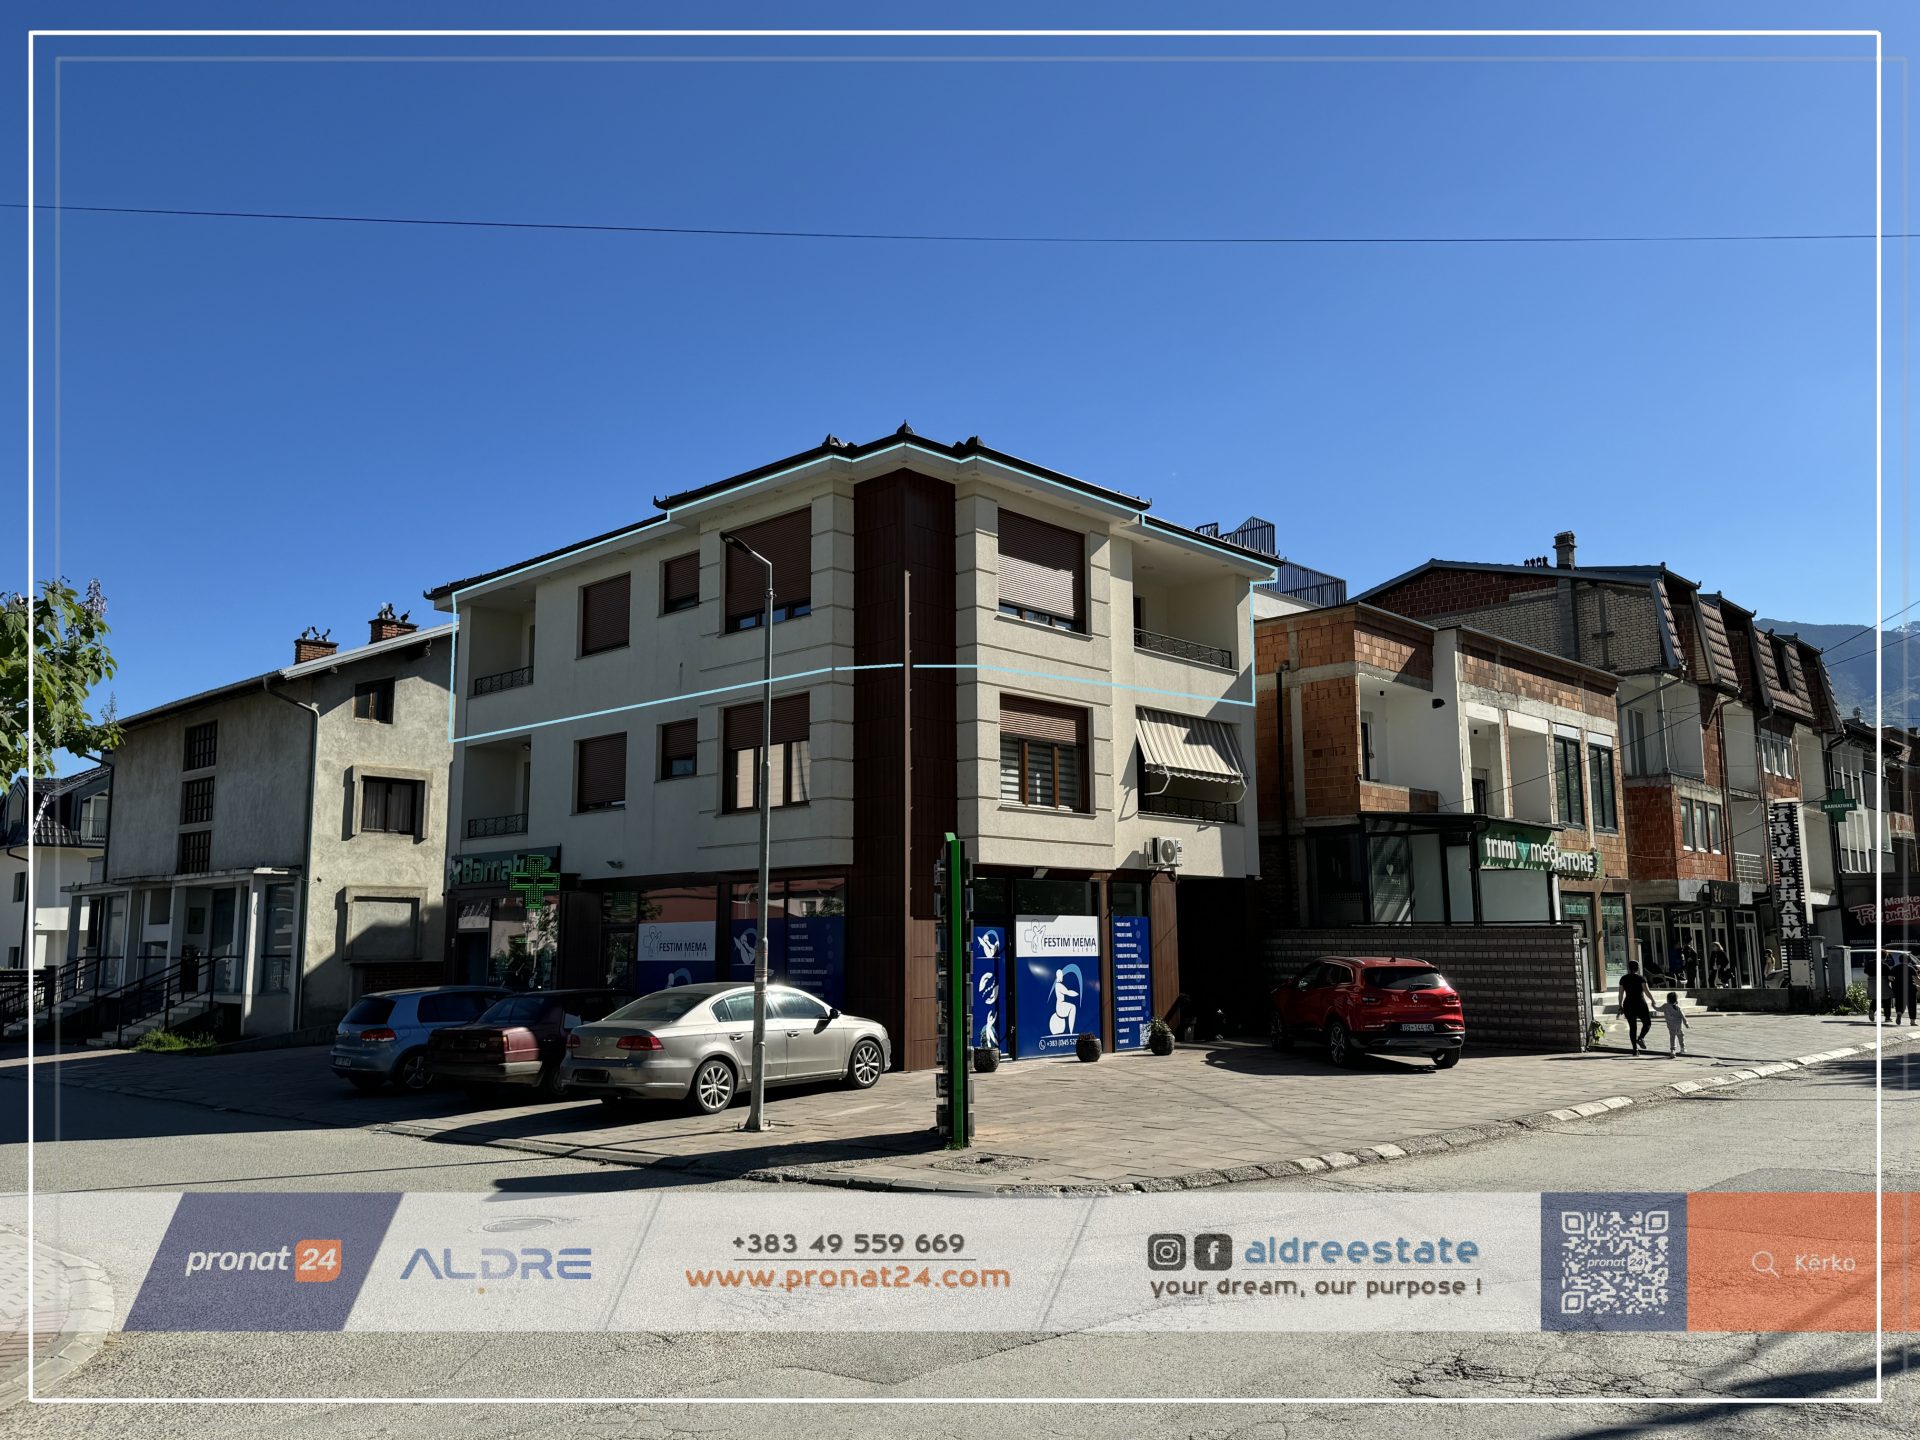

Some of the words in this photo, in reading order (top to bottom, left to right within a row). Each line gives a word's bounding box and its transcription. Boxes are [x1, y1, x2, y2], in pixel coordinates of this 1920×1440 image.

[1485, 835, 1517, 860] trimi
[1530, 840, 1558, 863] med
[1774, 807, 1796, 873] TRIMI
[462, 854, 552, 884] Barnat
[1779, 877, 1802, 939] PHARM
[658, 942, 683, 952] FESTIM
[684, 942, 707, 952] MEMA
[1043, 937, 1071, 947] FESTIM
[1072, 937, 1097, 947] MEMA
